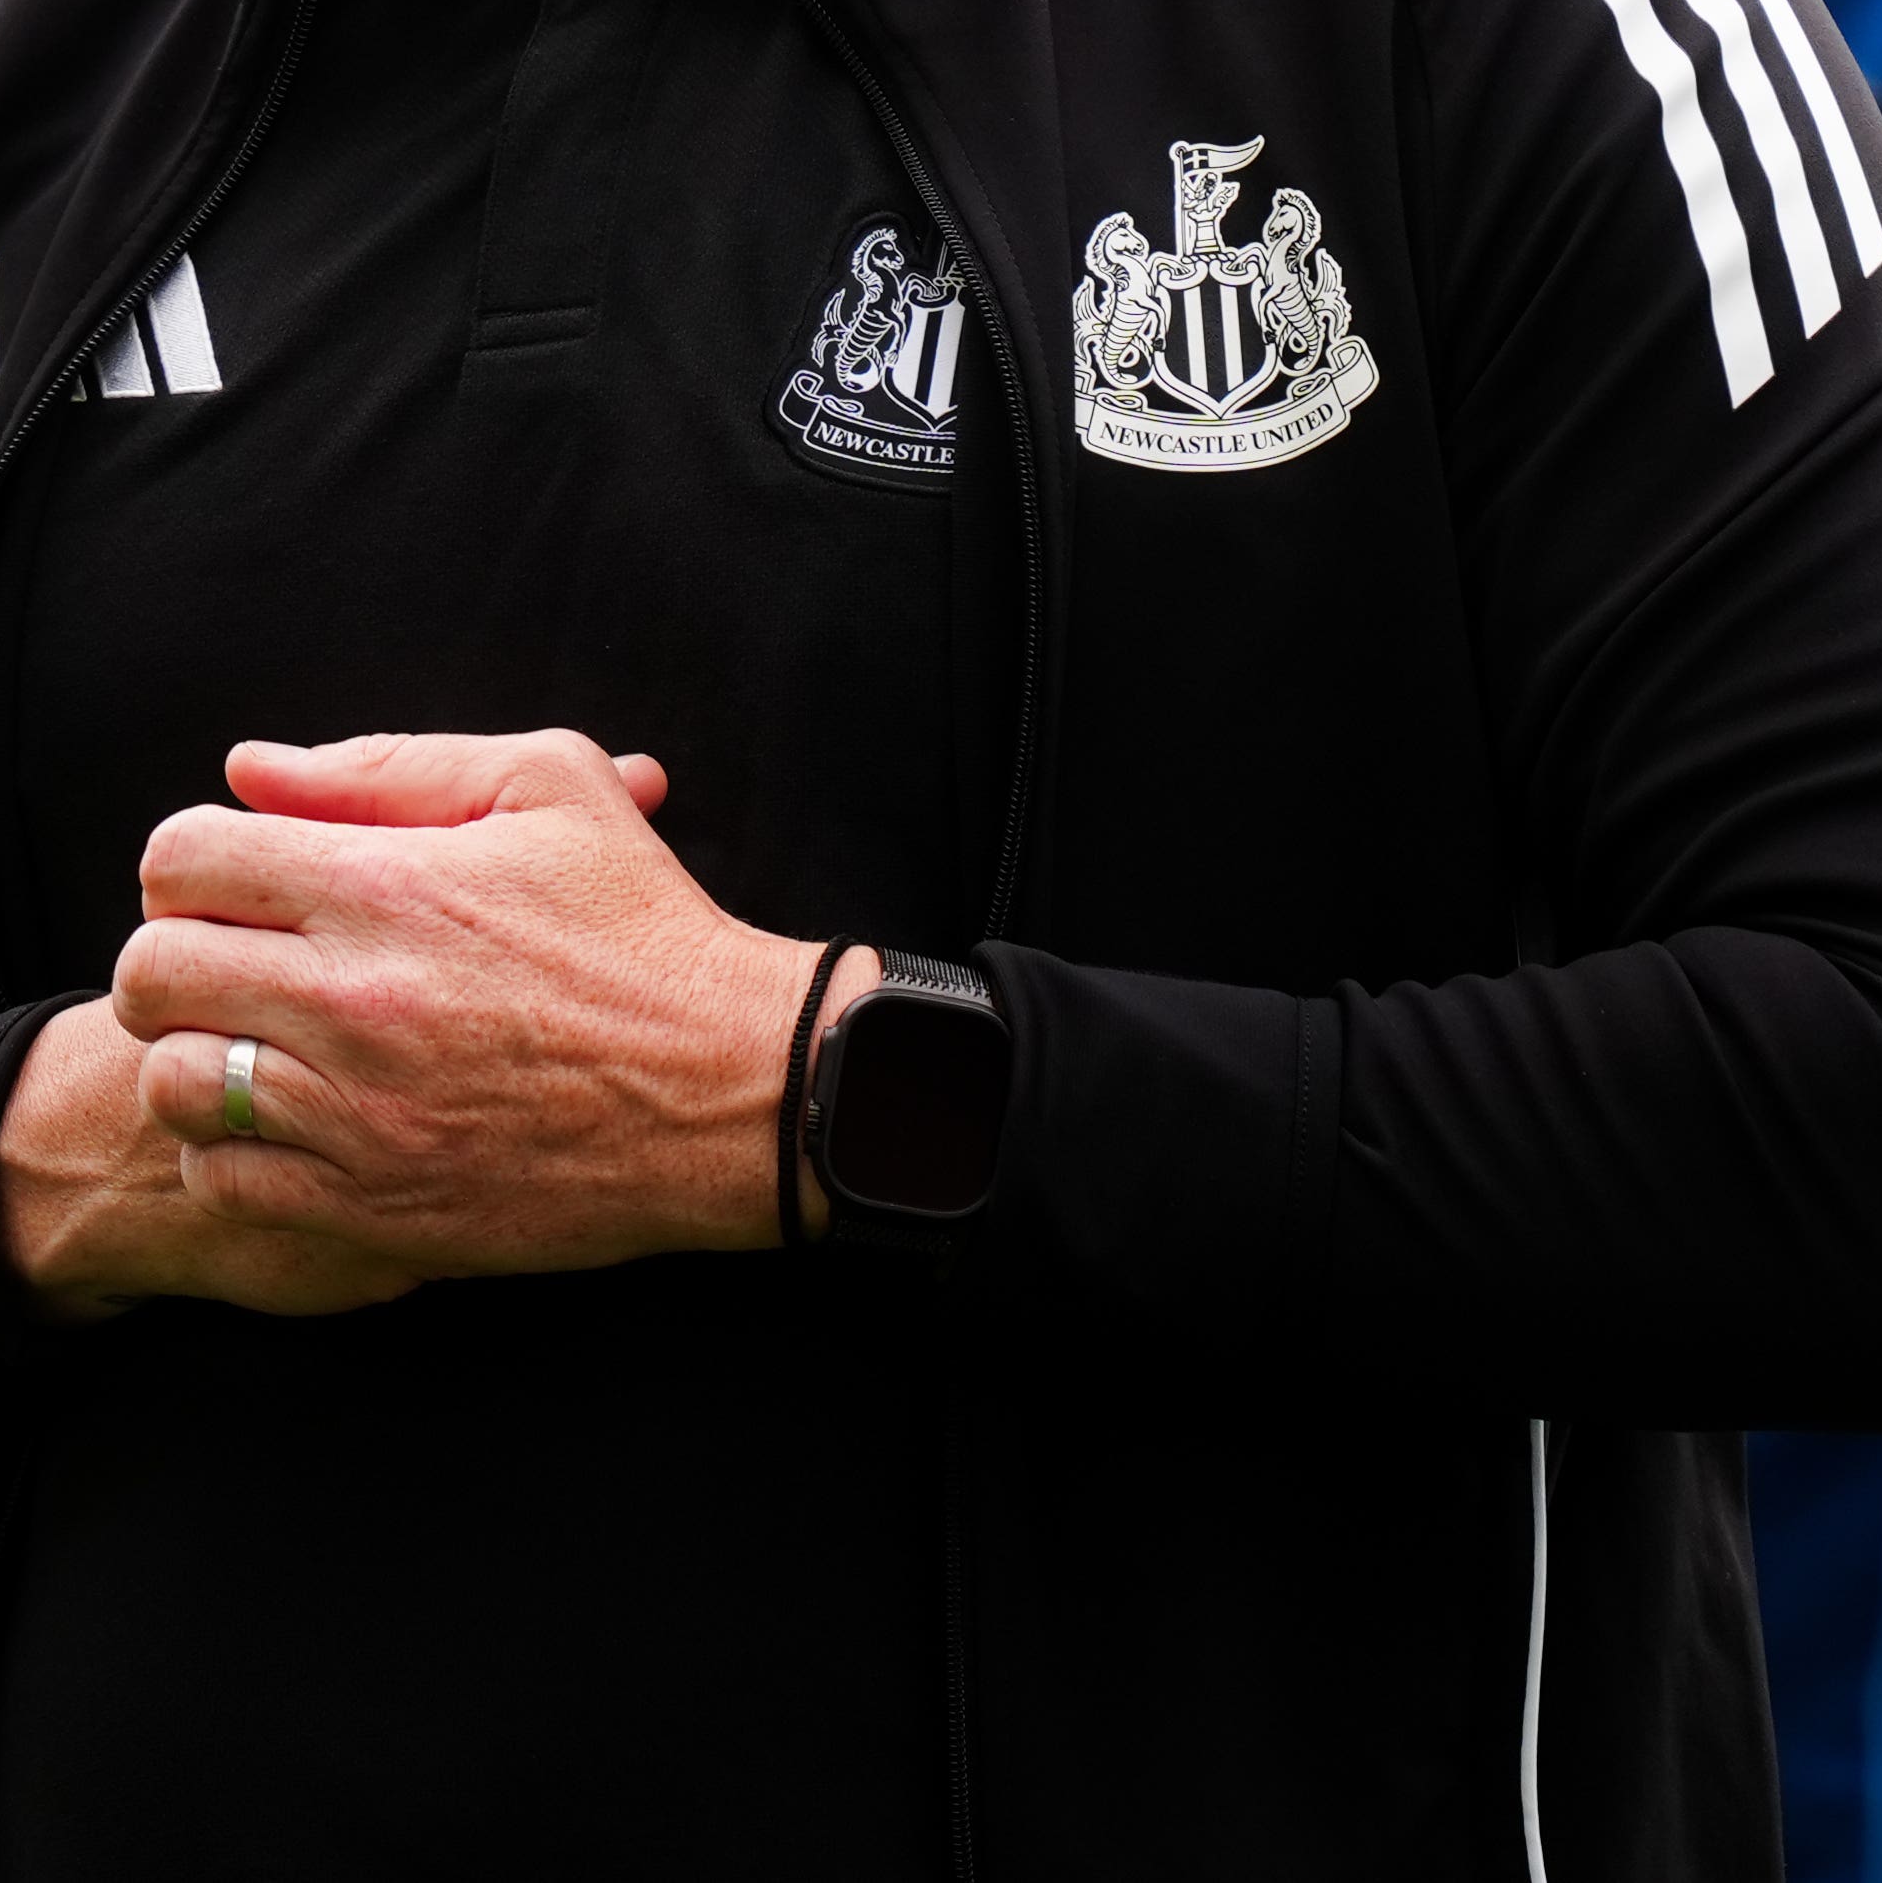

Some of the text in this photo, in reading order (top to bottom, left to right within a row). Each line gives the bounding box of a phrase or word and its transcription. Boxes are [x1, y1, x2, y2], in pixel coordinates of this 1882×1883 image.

[814, 421, 956, 464] NEWCASTLE
[1099, 403, 1334, 454] NEWCASTLE UNITED
